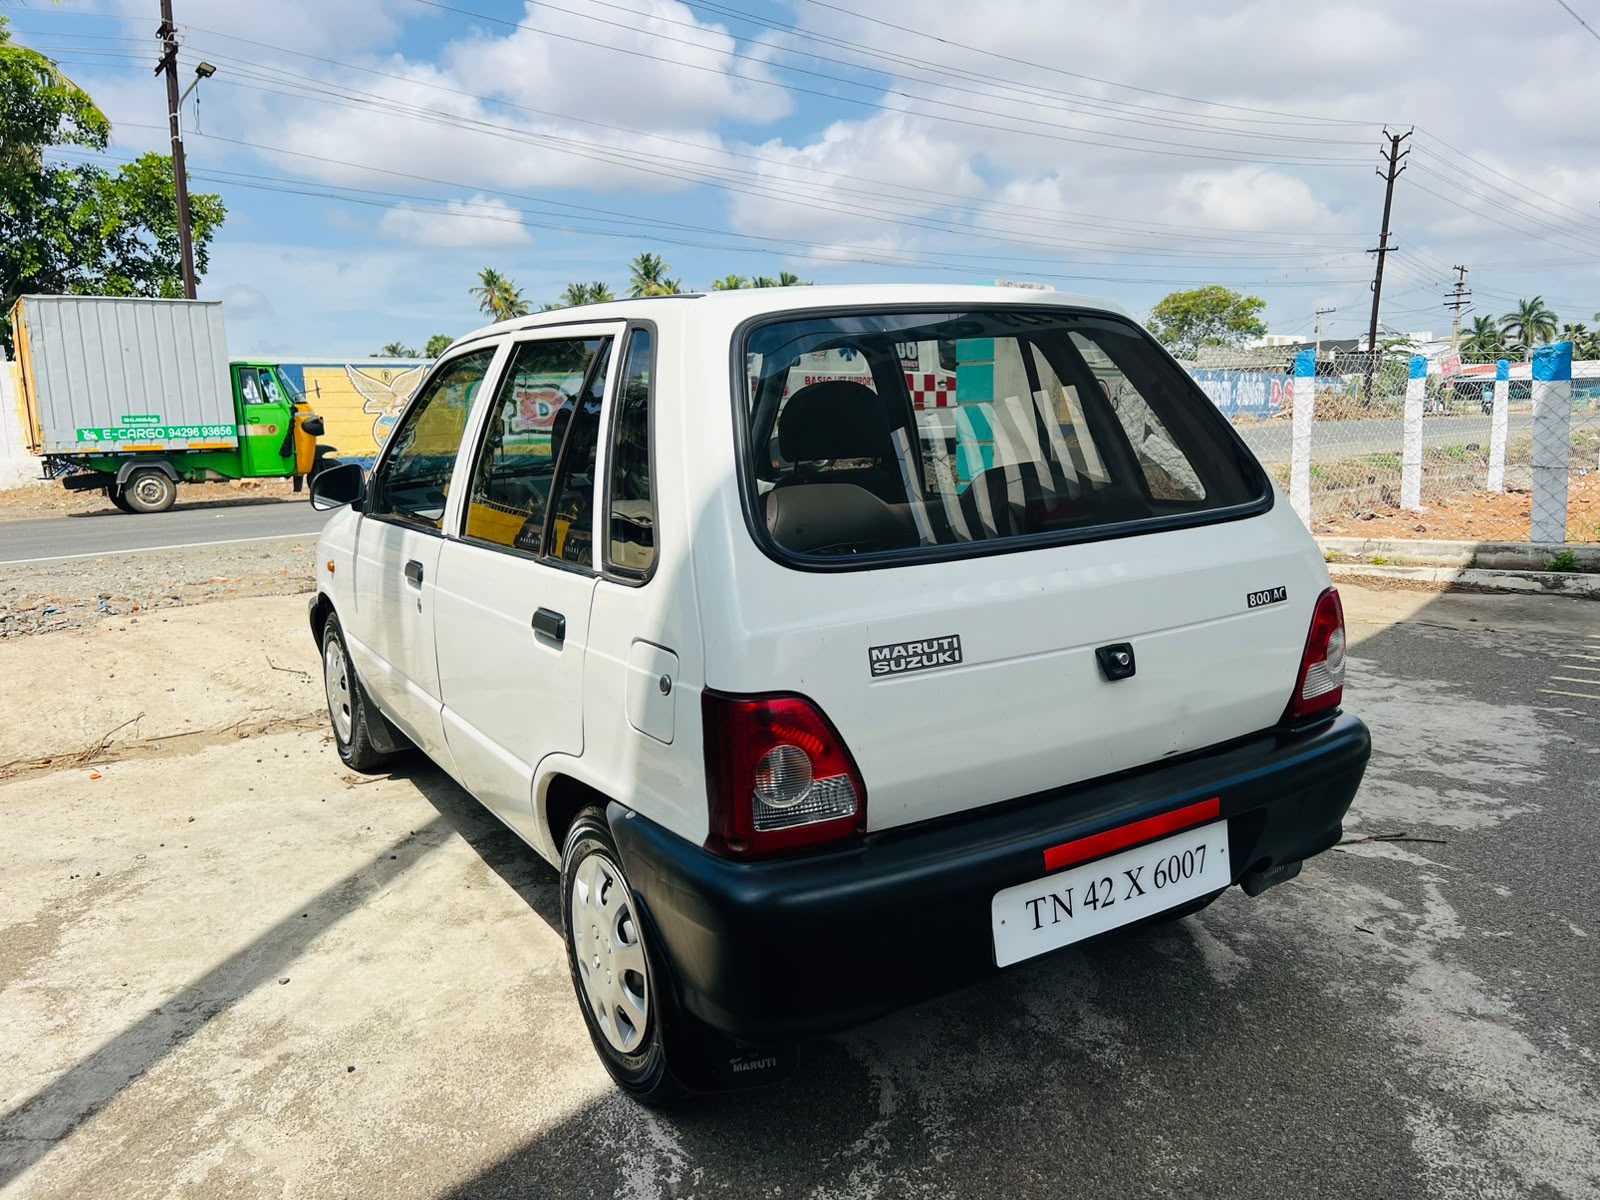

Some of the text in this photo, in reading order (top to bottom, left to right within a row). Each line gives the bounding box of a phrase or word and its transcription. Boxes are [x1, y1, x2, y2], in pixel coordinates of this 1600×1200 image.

[102, 425, 232, 440] E-CARGO 94296 93656
[1249, 587, 1285, 606] 800 AC
[871, 637, 959, 661] MARUTI
[873, 650, 960, 674] SUZUKI
[1025, 844, 1207, 931] TN 42 X 6007
[732, 1057, 777, 1073] MARUTI
